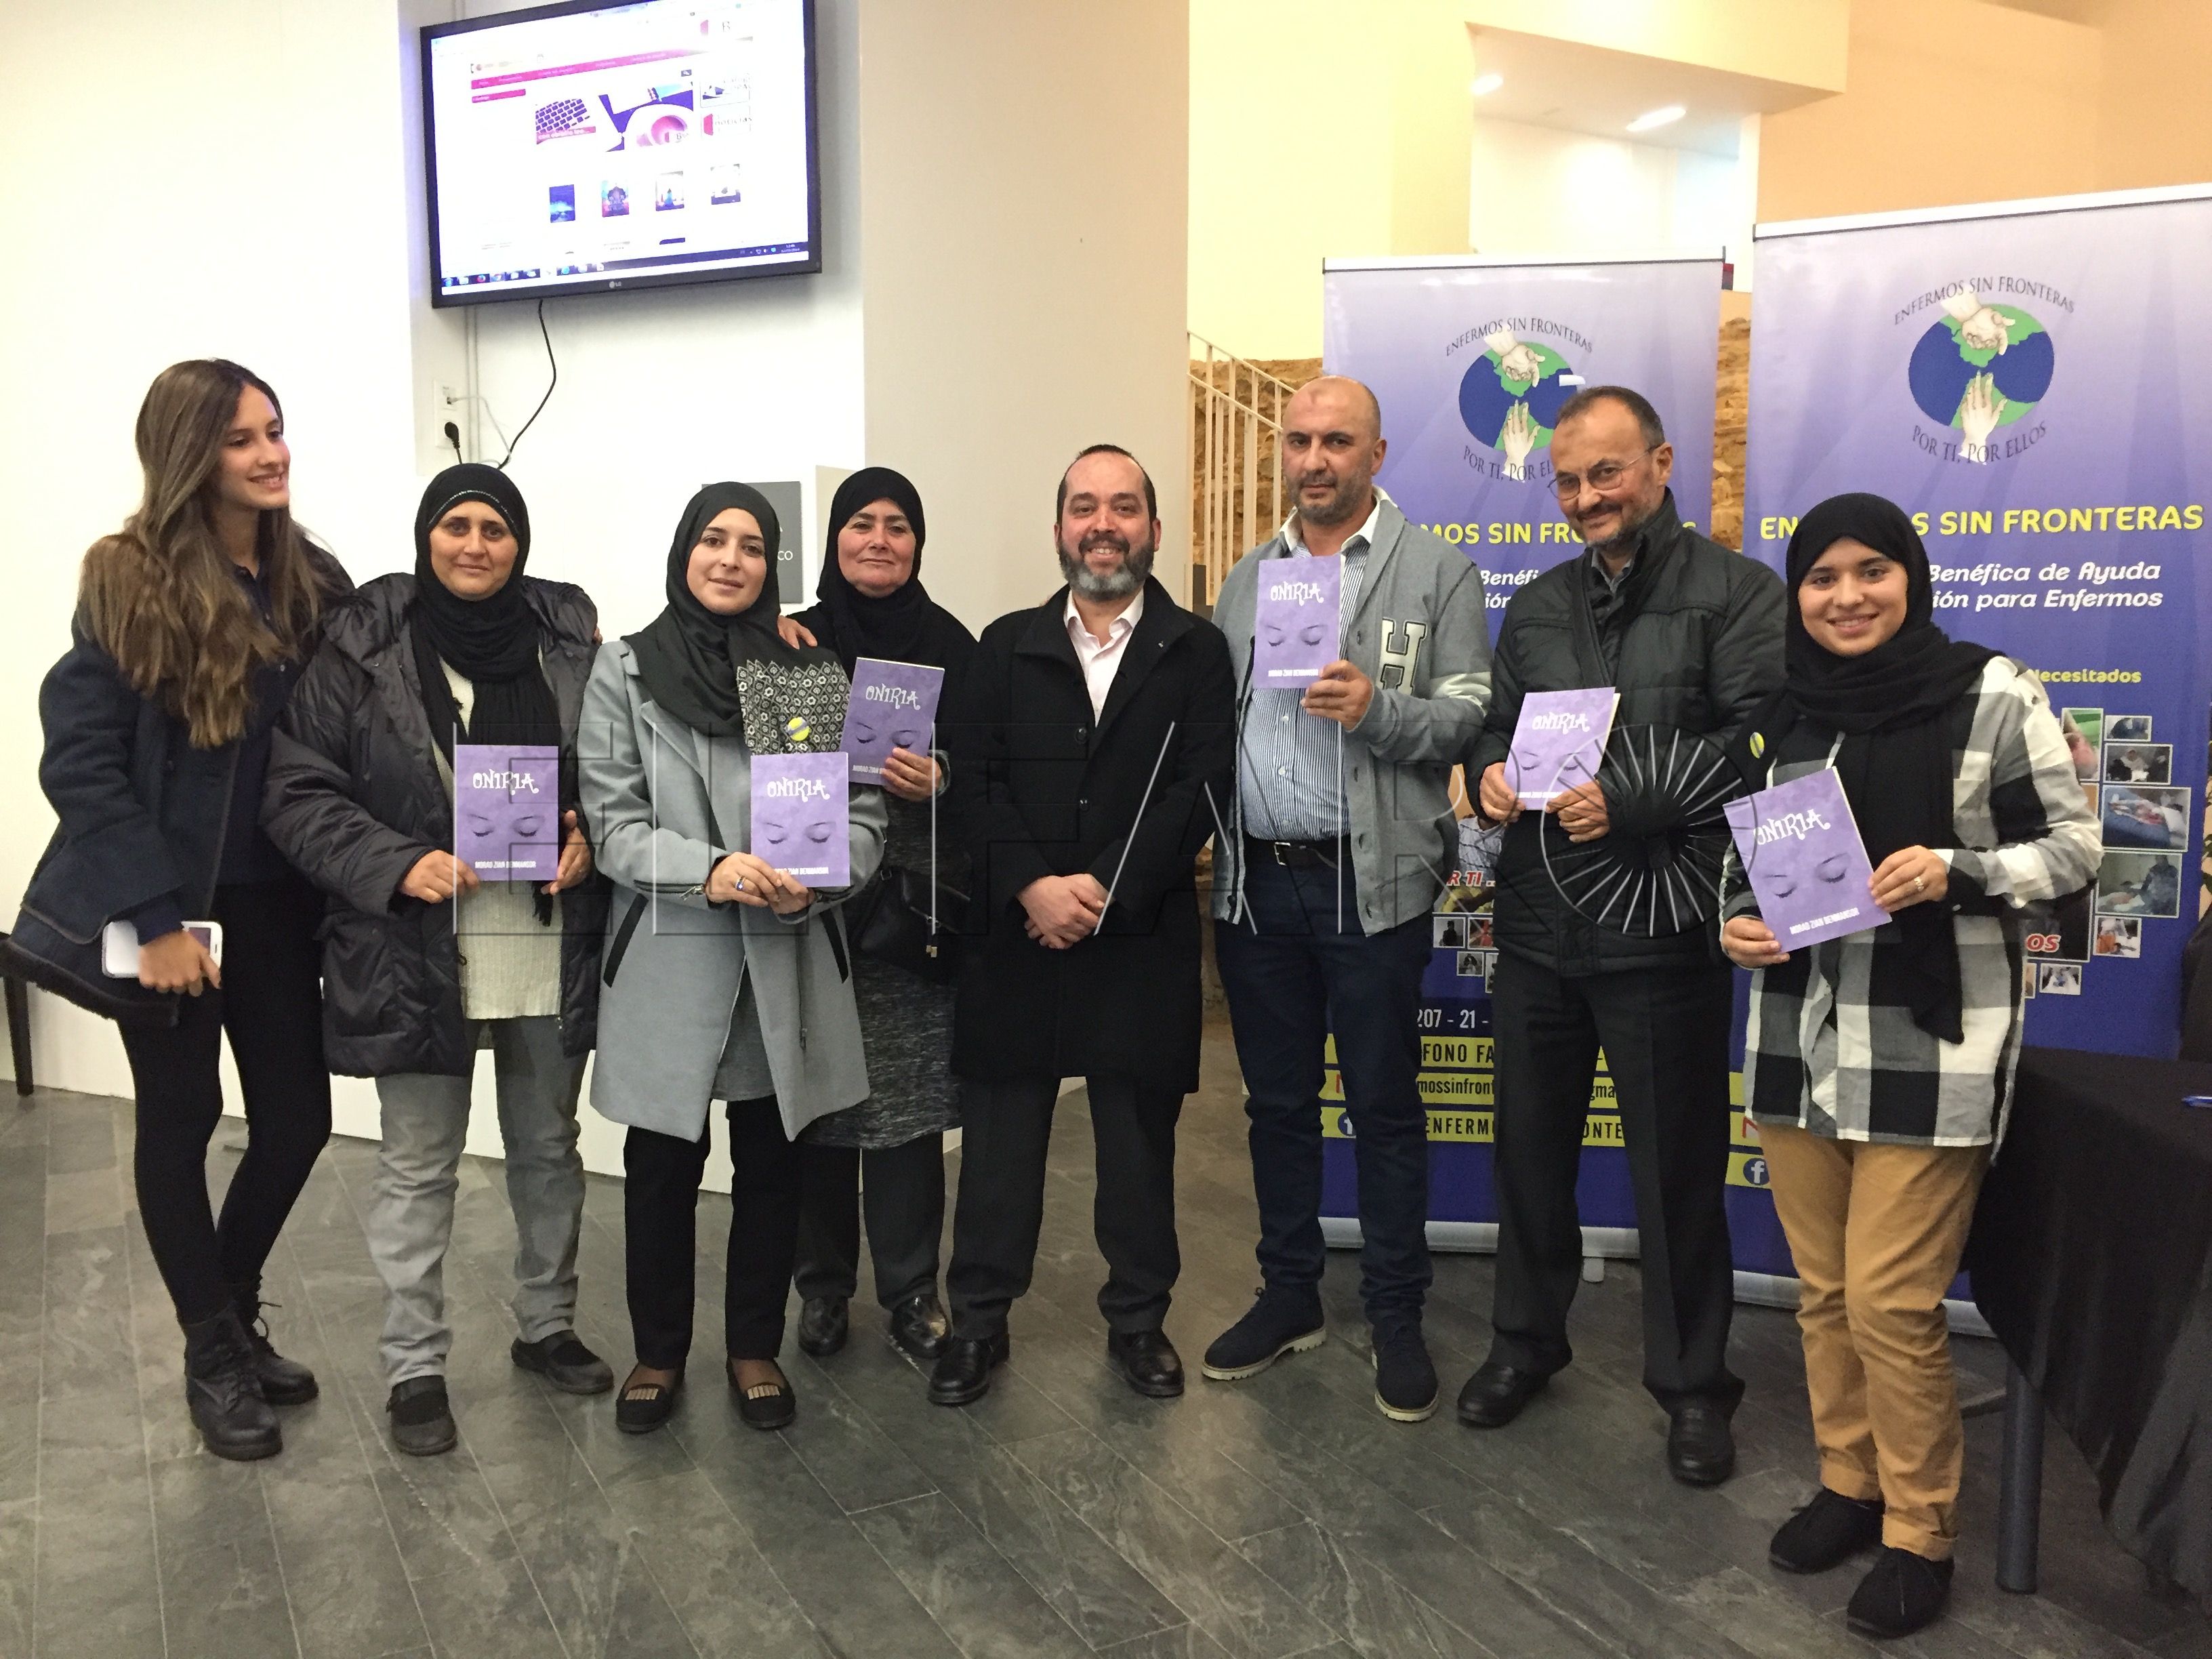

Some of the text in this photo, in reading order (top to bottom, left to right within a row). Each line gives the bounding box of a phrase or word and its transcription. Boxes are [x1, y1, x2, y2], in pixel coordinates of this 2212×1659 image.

[1894, 276, 2075, 325] ENFERMOS SIN FRONTERAS
[1446, 318, 1593, 356] ENFERMOS SIN FRONTERAS
[1912, 420, 2047, 464] POR TI, POR ELLOS
[1464, 446, 1554, 482] POR TI, POR EL
[1940, 510, 1992, 535] SIN
[2004, 505, 2204, 535] FRONTERAS
[1420, 523, 1480, 544] MOS
[1488, 523, 1531, 544] SIN
[777, 550, 793, 560] CO
[1480, 570, 1539, 586] Benéfi
[2039, 563, 2070, 581] de
[2079, 561, 2161, 586] Ayuda
[1270, 581, 1324, 607] ONIRIA
[1933, 590, 2163, 613] ión para Enfermos
[1378, 617, 1426, 695] H
[865, 683, 921, 710] ONIRIA
[1532, 712, 1590, 735] ONIRIA
[472, 769, 539, 796] ONIRIA
[767, 777, 830, 802] ONIRIA
[1446, 869, 1462, 886] R
[1465, 870, 1483, 886] TI
[2025, 933, 2061, 952] OS
[1460, 1010, 1475, 1028] 21
[1423, 1044, 1494, 1063] FONO FA
[1417, 1078, 1494, 1094] mossinfron
[1426, 1118, 1490, 1134] ENFERM
